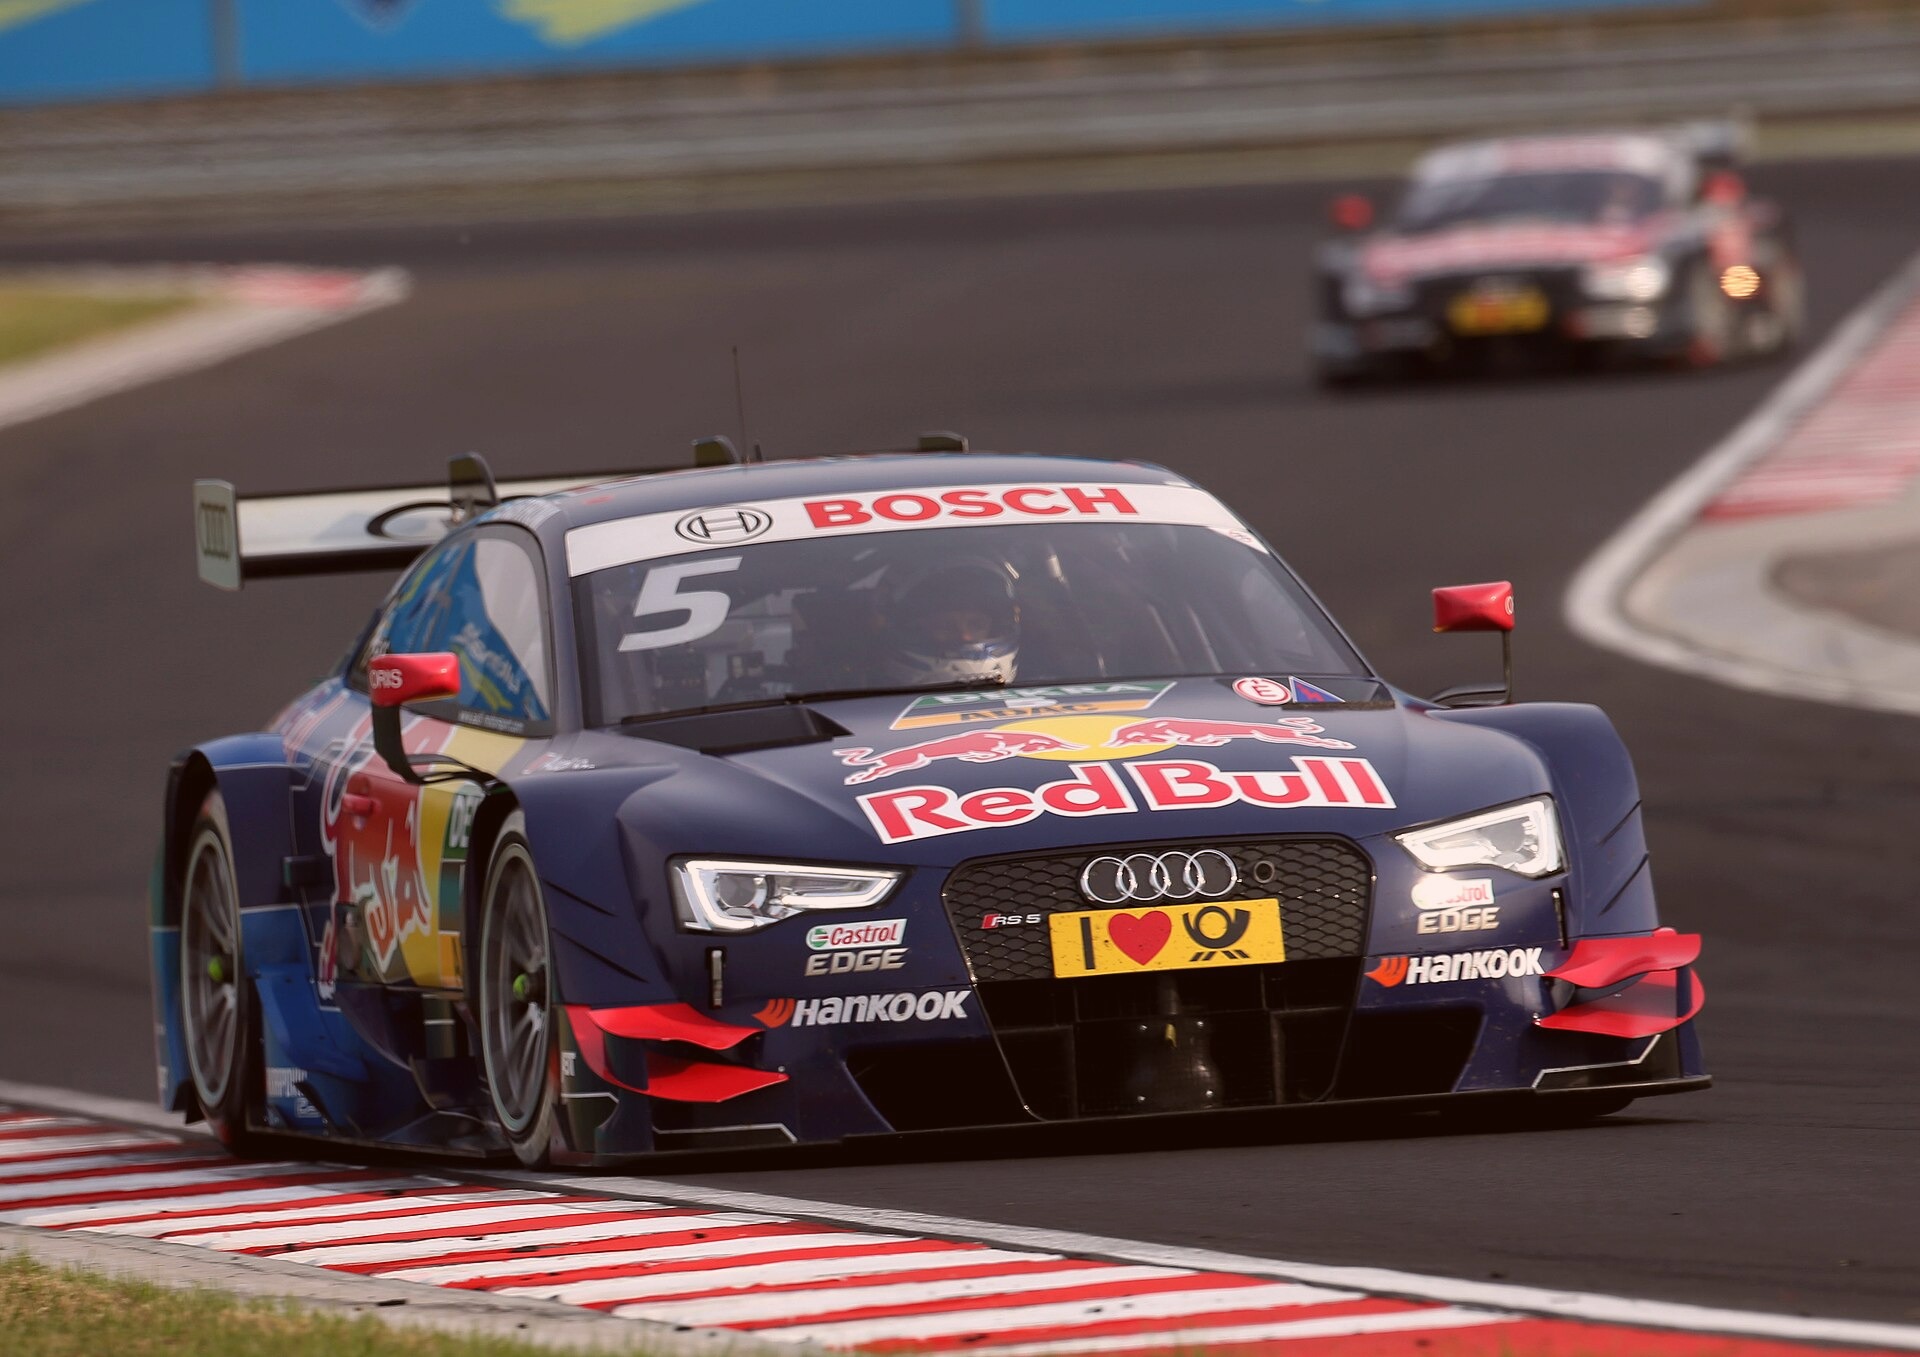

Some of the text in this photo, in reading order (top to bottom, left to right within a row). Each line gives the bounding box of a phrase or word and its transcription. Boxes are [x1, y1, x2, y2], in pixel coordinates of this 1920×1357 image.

[803, 487, 1139, 530] BOSCH
[616, 555, 743, 652] 5
[933, 682, 1156, 705] DEKRA
[862, 757, 1391, 842] Red Bull
[991, 913, 1042, 926] RS 5
[1416, 906, 1501, 935] EDGE
[830, 923, 898, 947] Castrol
[1079, 916, 1097, 970] I
[804, 948, 910, 977] EDGE
